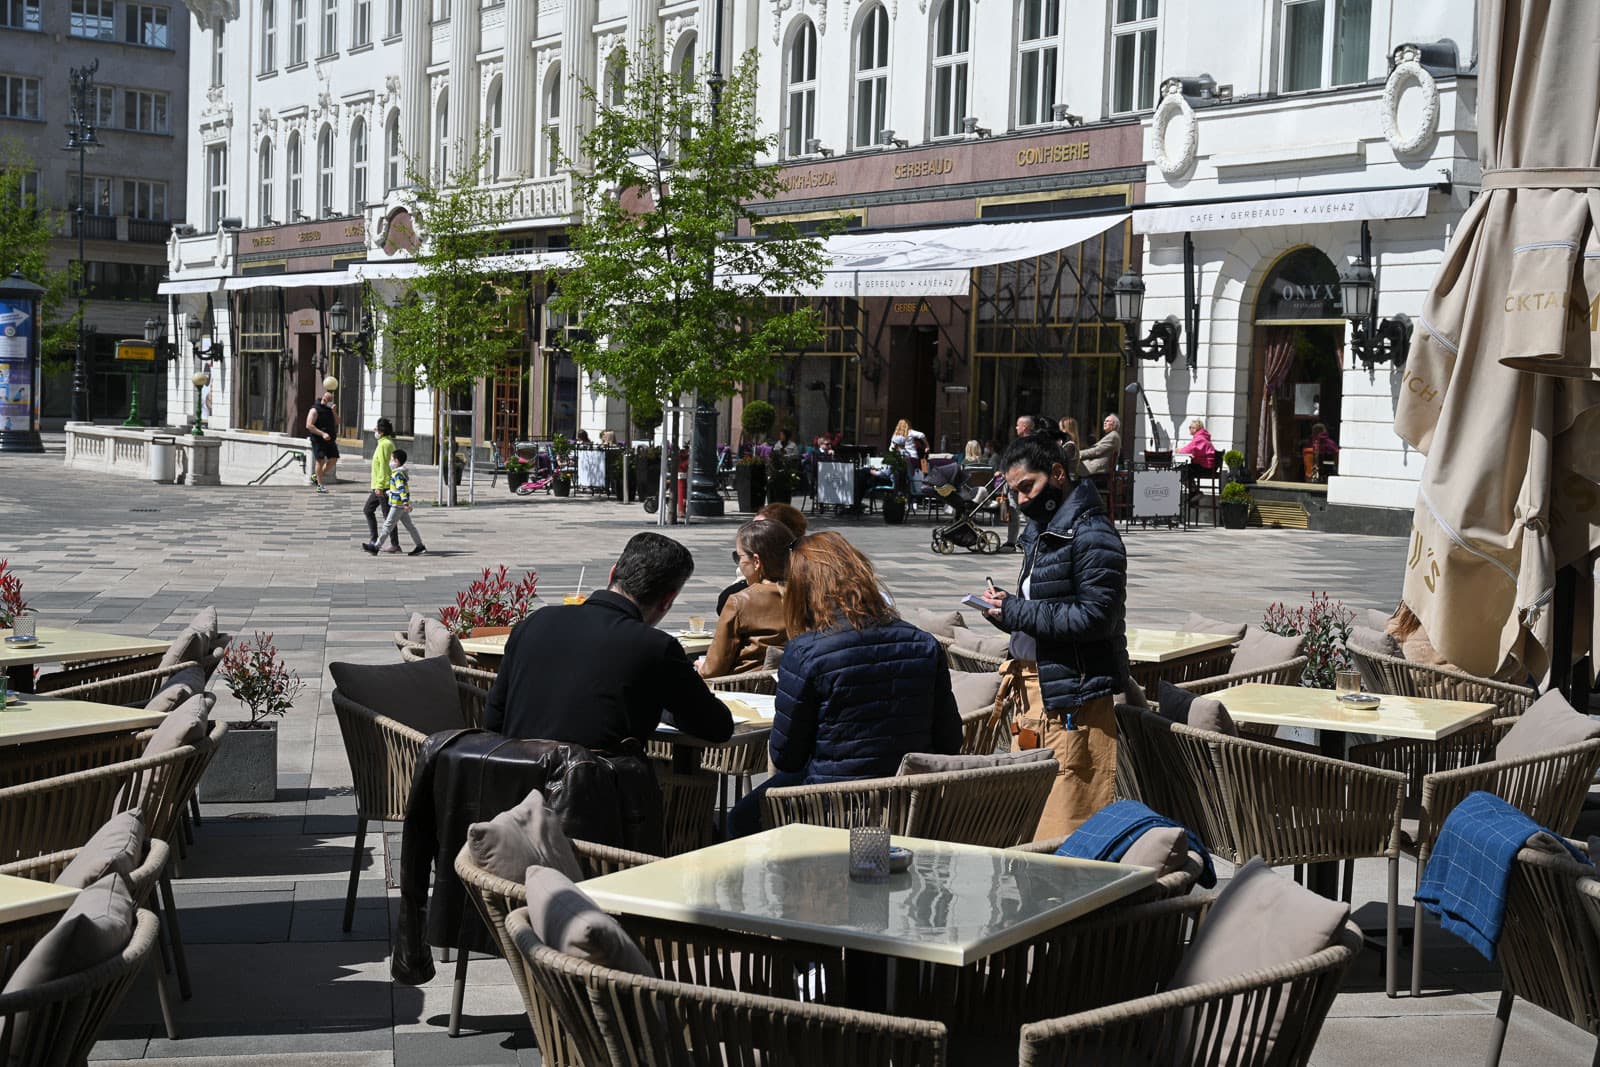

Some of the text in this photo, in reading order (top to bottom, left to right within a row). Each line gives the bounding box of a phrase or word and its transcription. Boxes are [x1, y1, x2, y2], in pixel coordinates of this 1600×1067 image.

[1017, 142, 1090, 167] CONFISERIE
[894, 158, 953, 180] GERBEAUD
[1231, 208, 1286, 220] GERBEAUD
[1283, 284, 1335, 301] ONYX
